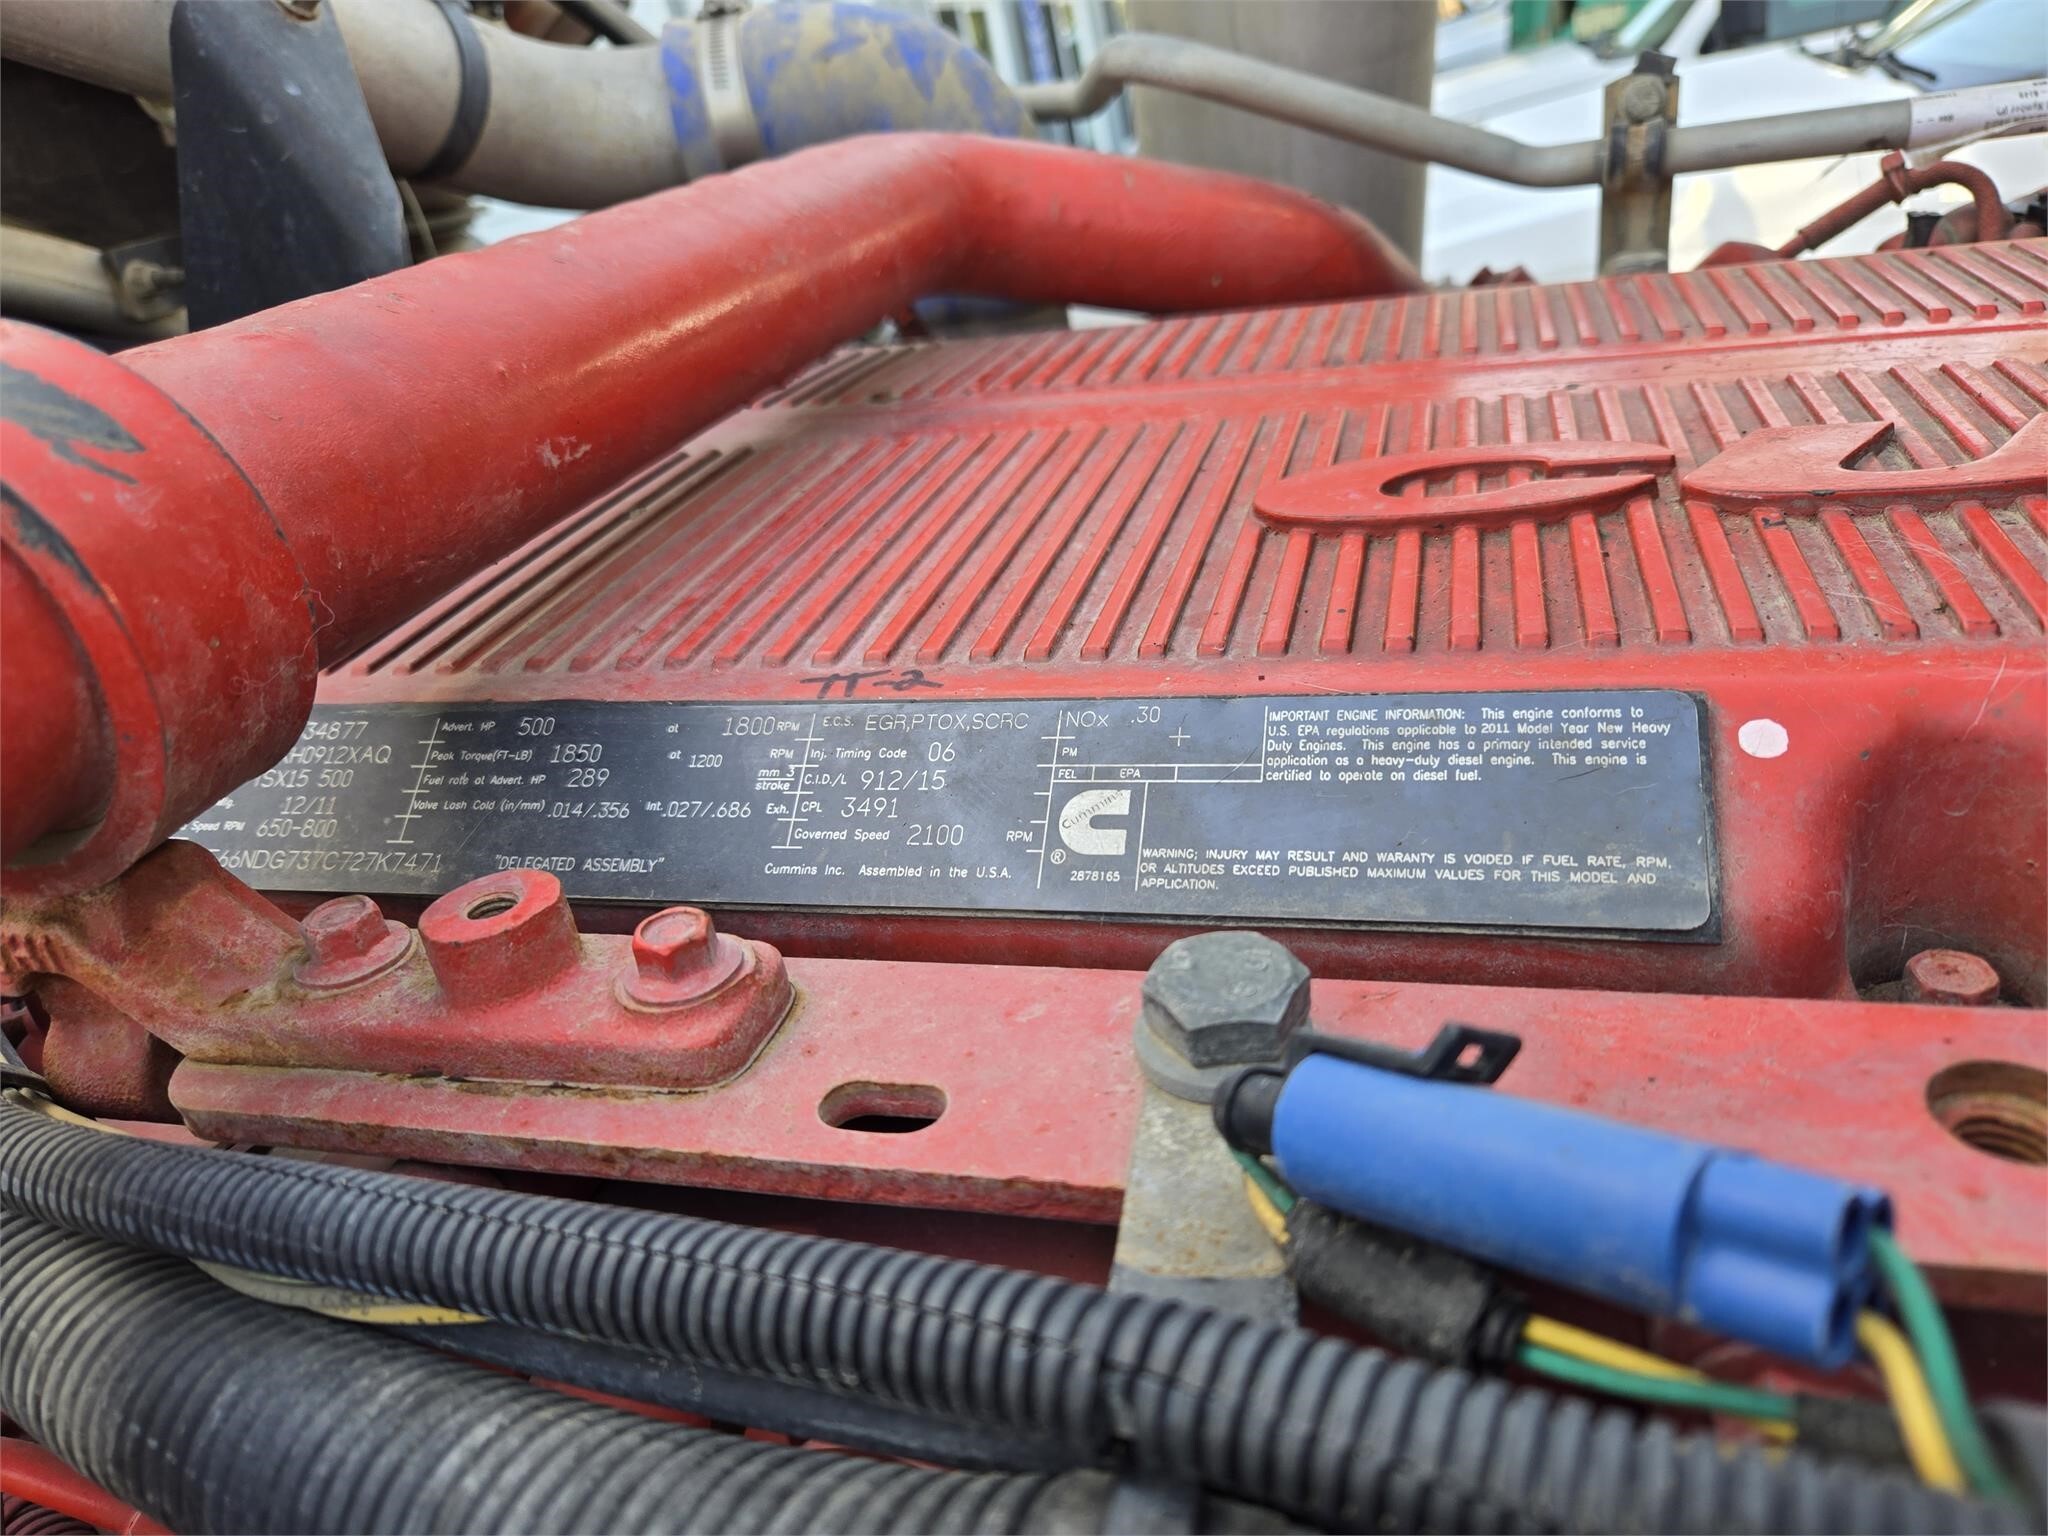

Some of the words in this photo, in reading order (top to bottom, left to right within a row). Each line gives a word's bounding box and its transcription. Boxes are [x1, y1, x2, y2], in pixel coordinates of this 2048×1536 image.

[823, 716, 854, 727] E.C.S.
[865, 713, 1029, 732] EGR,PTOX,SCRC
[1066, 711, 1109, 727] NOx
[1130, 706, 1161, 723] .30
[1269, 710, 1330, 721] IMPORTANT
[1336, 709, 1378, 721] ENGINE
[1385, 708, 1465, 720] INFORMATION:
[1481, 707, 1505, 720] This
[1513, 707, 1553, 722] engine
[1561, 706, 1622, 719] conforms
[1630, 706, 1644, 718] to
[441, 721, 474, 732] Advert.
[480, 721, 496, 732] HP
[518, 717, 556, 736] 500
[667, 723, 679, 733] at
[721, 716, 776, 736] 1800
[776, 721, 800, 732] RPM
[1268, 725, 1290, 736] U.S.
[1297, 725, 1320, 736] EPA
[1326, 724, 1390, 739] regulations
[1397, 723, 1457, 738] applicable
[1464, 724, 1477, 735] to
[1481, 723, 1509, 734] 2011
[1517, 722, 1553, 734] Model
[1561, 722, 1589, 733] Year
[1597, 722, 1623, 733] New
[1632, 722, 1671, 736] Heavy
[550, 744, 602, 763] 1850
[770, 749, 793, 759] RPM
[810, 748, 827, 760] Inj.
[835, 748, 871, 760] Timing
[879, 748, 907, 759] Code
[928, 742, 955, 762] 06
[1062, 747, 1078, 757] PM
[1267, 739, 1292, 754] Duty
[1299, 739, 1346, 754] Engines.
[1362, 739, 1384, 751] This
[1392, 739, 1431, 753] engine
[1438, 739, 1460, 750] has
[1467, 741, 1476, 750] a
[1484, 739, 1531, 752] primary
[1538, 738, 1592, 749] intended
[1601, 738, 1646, 749] service
[431, 751, 454, 761] Peak
[461, 750, 533, 763] Torque(FT-LB)
[669, 751, 682, 760] at
[688, 754, 723, 768] 1200
[1267, 755, 1328, 768] application
[1335, 757, 1349, 766] as
[1356, 757, 1364, 766] a
[1371, 754, 1440, 768] heavy-duty
[1448, 754, 1483, 765] diesel
[1490, 754, 1535, 768] engine.
[1552, 753, 1577, 765] This
[1585, 754, 1628, 768] engine
[1636, 753, 1647, 765] is
[318, 769, 354, 788] 500
[423, 775, 444, 785] Fuel
[449, 773, 469, 785] rate
[475, 775, 484, 785] at
[490, 775, 524, 785] Advert.
[531, 774, 547, 785] HP
[567, 768, 610, 788] 289
[758, 769, 780, 778] mm
[786, 767, 795, 778] 3
[804, 773, 847, 787] C.I.D./L
[861, 770, 947, 791] 912/15
[1058, 768, 1077, 779] FEL
[1119, 768, 1141, 779] EPA
[1266, 770, 1312, 781] certified
[1320, 770, 1331, 781] to
[1338, 771, 1383, 784] operate
[1391, 772, 1405, 781] on
[1413, 770, 1448, 781] diesel
[1456, 770, 1482, 781] fuel.
[755, 781, 790, 791] stroke
[280, 796, 337, 815] 12/11
[413, 800, 438, 810] Valve
[444, 800, 467, 811] Lash
[473, 800, 494, 810] Cold
[501, 799, 545, 812] (in/mm)
[548, 802, 630, 818] .014/.356
[646, 801, 663, 811] Int.
[663, 801, 751, 818] .027/.686
[766, 804, 790, 815] Exh.
[800, 802, 822, 813] CPL
[841, 797, 898, 818] 3491
[1062, 790, 1126, 829] Cummins
[223, 820, 246, 831] RPM
[256, 818, 338, 837] 650-800
[794, 829, 847, 841] Governed
[854, 829, 890, 842] Speed
[906, 824, 964, 846] 2100
[1006, 831, 1033, 842] RPM
[209, 848, 441, 873] 66NDG737C727K7471
[1206, 850, 1248, 860] INJURY
[1255, 851, 1280, 861] MAY
[1288, 851, 1335, 862] RESULT
[1342, 852, 1368, 862] AND
[1444, 853, 1456, 864] IS
[1464, 854, 1512, 865] VOIDED
[1522, 854, 1534, 865] IF
[1542, 855, 1578, 866] FUEL
[1587, 856, 1626, 869] RATE,
[764, 864, 817, 876] Cummins
[825, 864, 845, 876] Inc.
[858, 865, 922, 877] Assembled
[929, 866, 940, 877] in
[949, 866, 967, 878] the
[976, 867, 1012, 879] U.S.A.
[1070, 870, 1120, 882] 2878165
[1140, 863, 1157, 874] OR
[1164, 864, 1225, 875] ALTITUDES
[1233, 864, 1280, 876] EXCEED
[1289, 866, 1359, 878] PUBLISHED
[1367, 868, 1426, 879] MAXIMUM
[1435, 869, 1485, 880] VALUES
[1494, 869, 1521, 880] FOR
[1531, 870, 1560, 882] THIS
[1570, 871, 1617, 883] MODEL
[1627, 872, 1656, 884] AND
[1140, 878, 1219, 890] APPLICATION.
